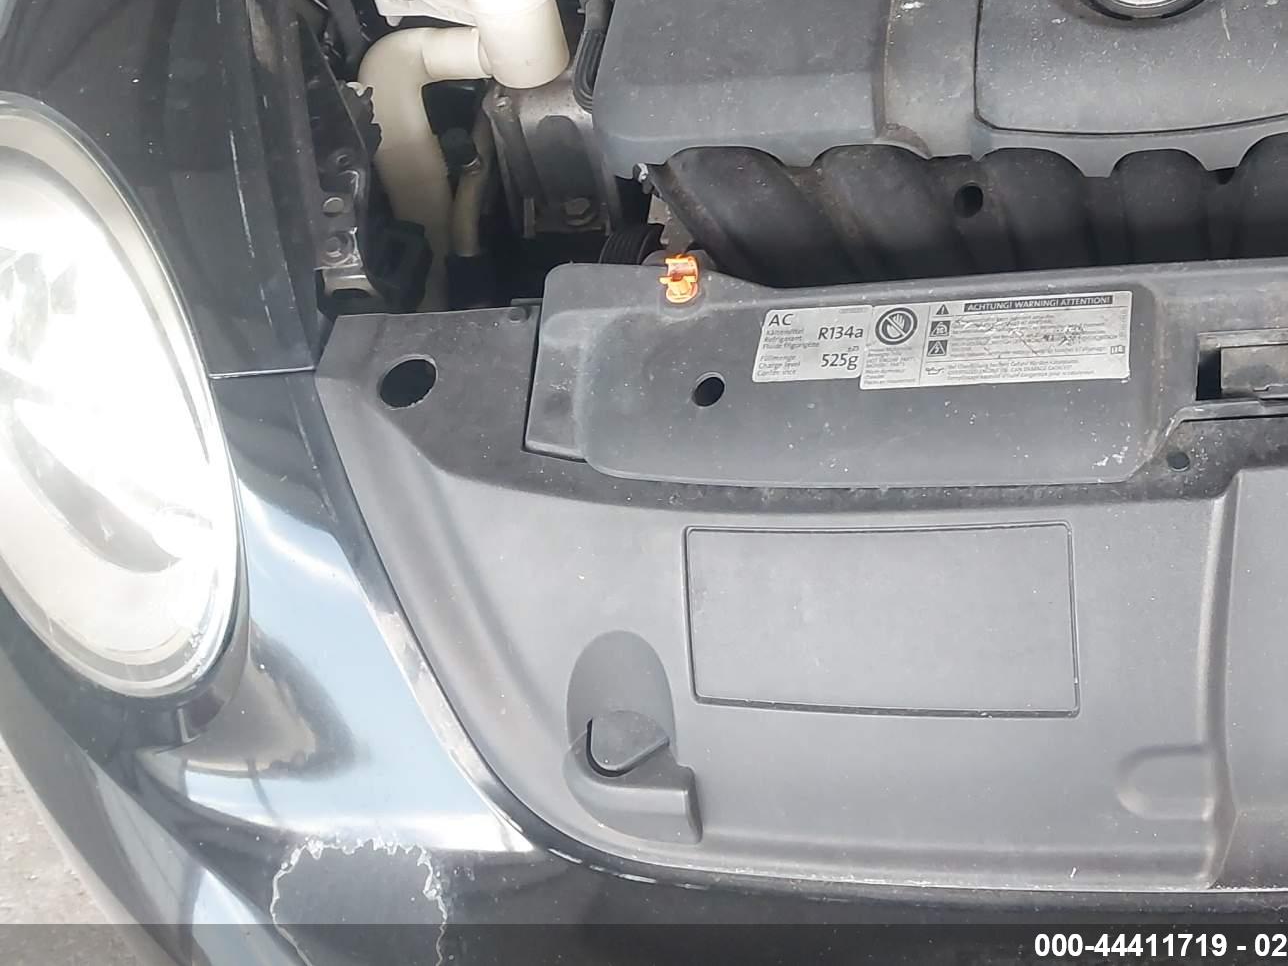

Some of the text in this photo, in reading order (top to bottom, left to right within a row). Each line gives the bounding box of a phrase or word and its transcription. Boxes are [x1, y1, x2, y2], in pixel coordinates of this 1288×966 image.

[967, 297, 1111, 311] ACHTUNG! WARNING! ATTENTION!
[769, 313, 794, 326] AC
[817, 326, 864, 340] R134a
[821, 353, 859, 371] 525g
